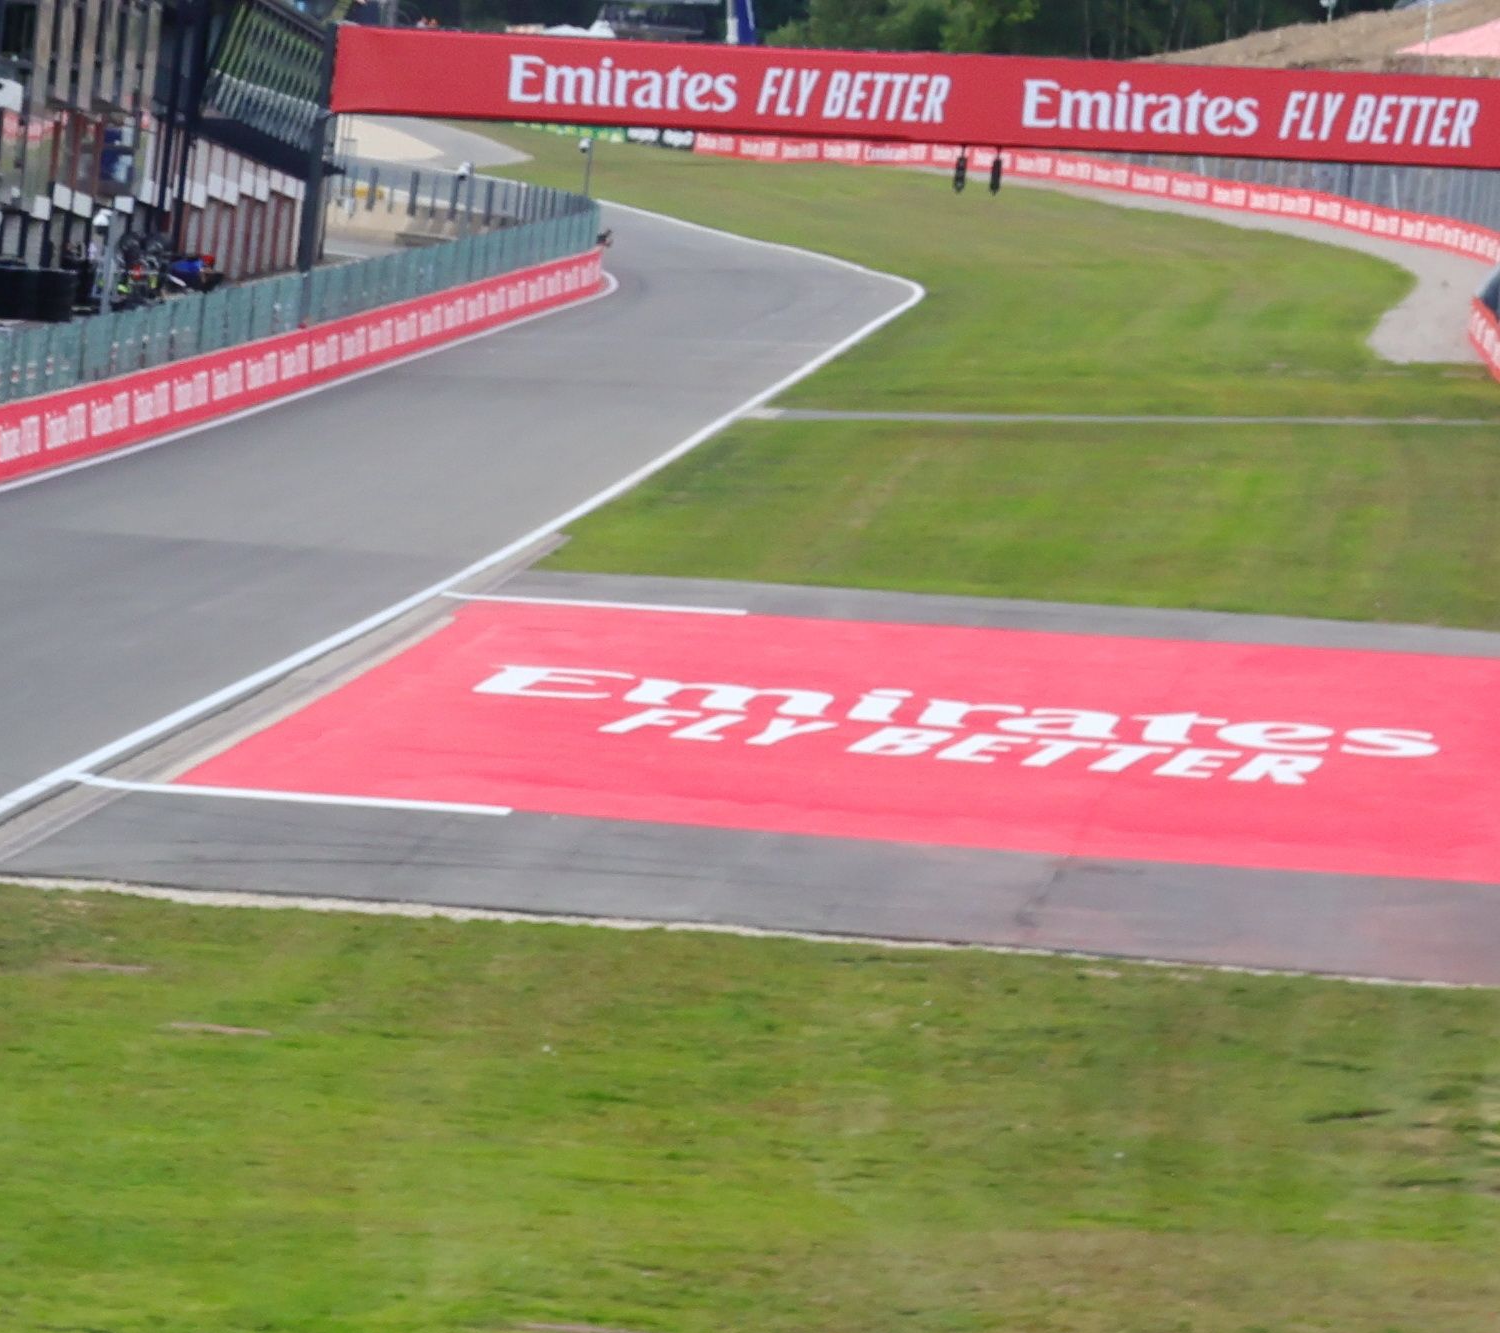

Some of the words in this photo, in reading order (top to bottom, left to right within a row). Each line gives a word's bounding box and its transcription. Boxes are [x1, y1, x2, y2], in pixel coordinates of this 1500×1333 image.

[508, 54, 738, 114] Emirates
[756, 67, 820, 118] FLY
[822, 70, 952, 124] BETTER
[1021, 78, 1260, 137] Emirates
[1278, 90, 1346, 141] FLY
[1346, 94, 1480, 148] BETTER
[473, 664, 1441, 758] Emirates
[597, 708, 839, 747] FLY
[845, 725, 1325, 786] BETTER
